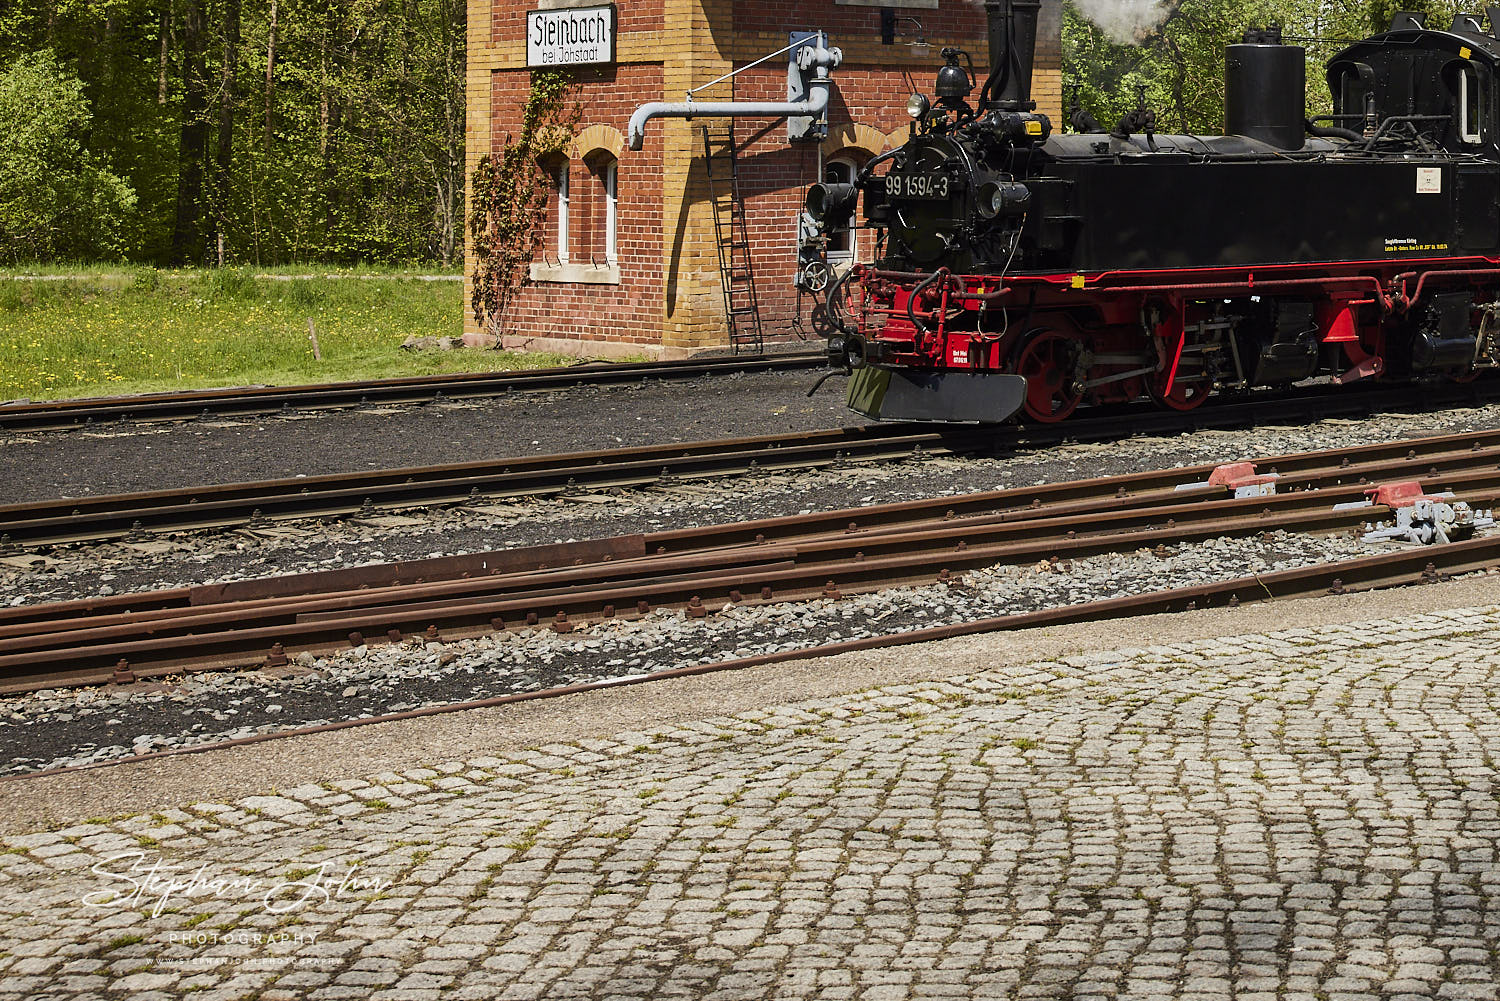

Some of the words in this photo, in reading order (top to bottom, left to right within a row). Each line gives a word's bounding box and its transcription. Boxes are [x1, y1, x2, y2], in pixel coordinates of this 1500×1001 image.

[534, 12, 606, 47] Steinbach
[542, 48, 556, 63] bei
[885, 176, 902, 195] 99
[904, 176, 949, 197] 1594-3
